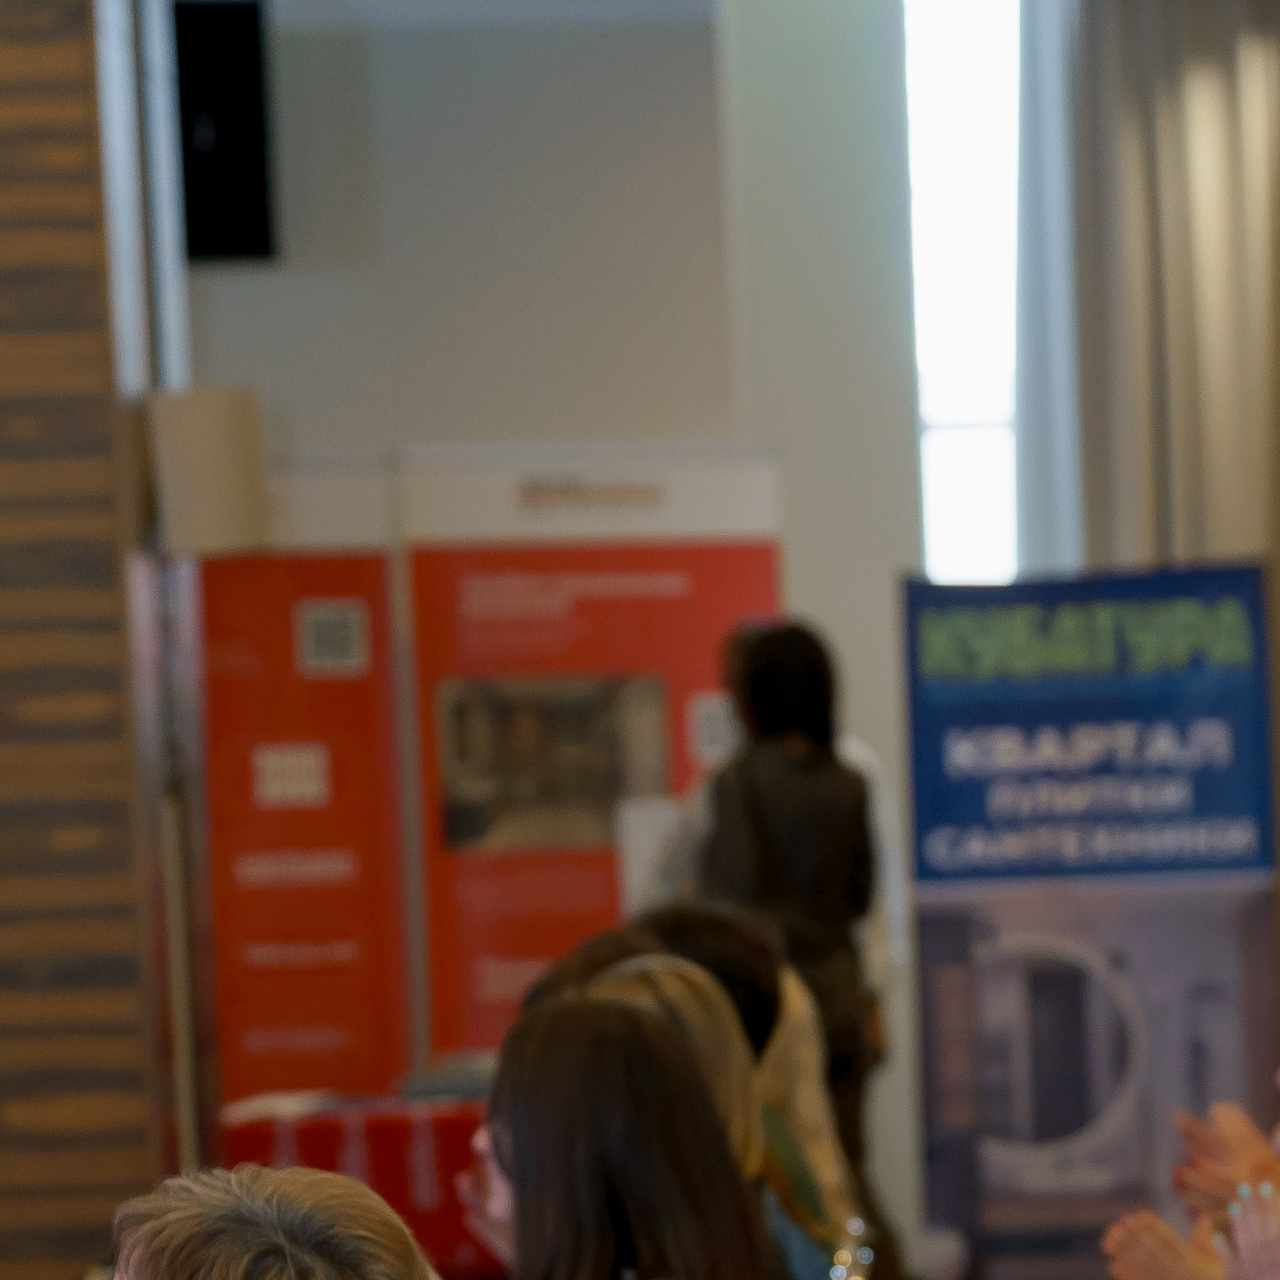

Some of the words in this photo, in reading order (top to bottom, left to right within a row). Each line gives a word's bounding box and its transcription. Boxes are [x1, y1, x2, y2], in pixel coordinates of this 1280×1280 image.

[943, 719, 1234, 777] КВАРТАЛ
[987, 777, 1193, 819] ПЛИТКИ
[924, 820, 1259, 871] САНТЕХНИКИ
